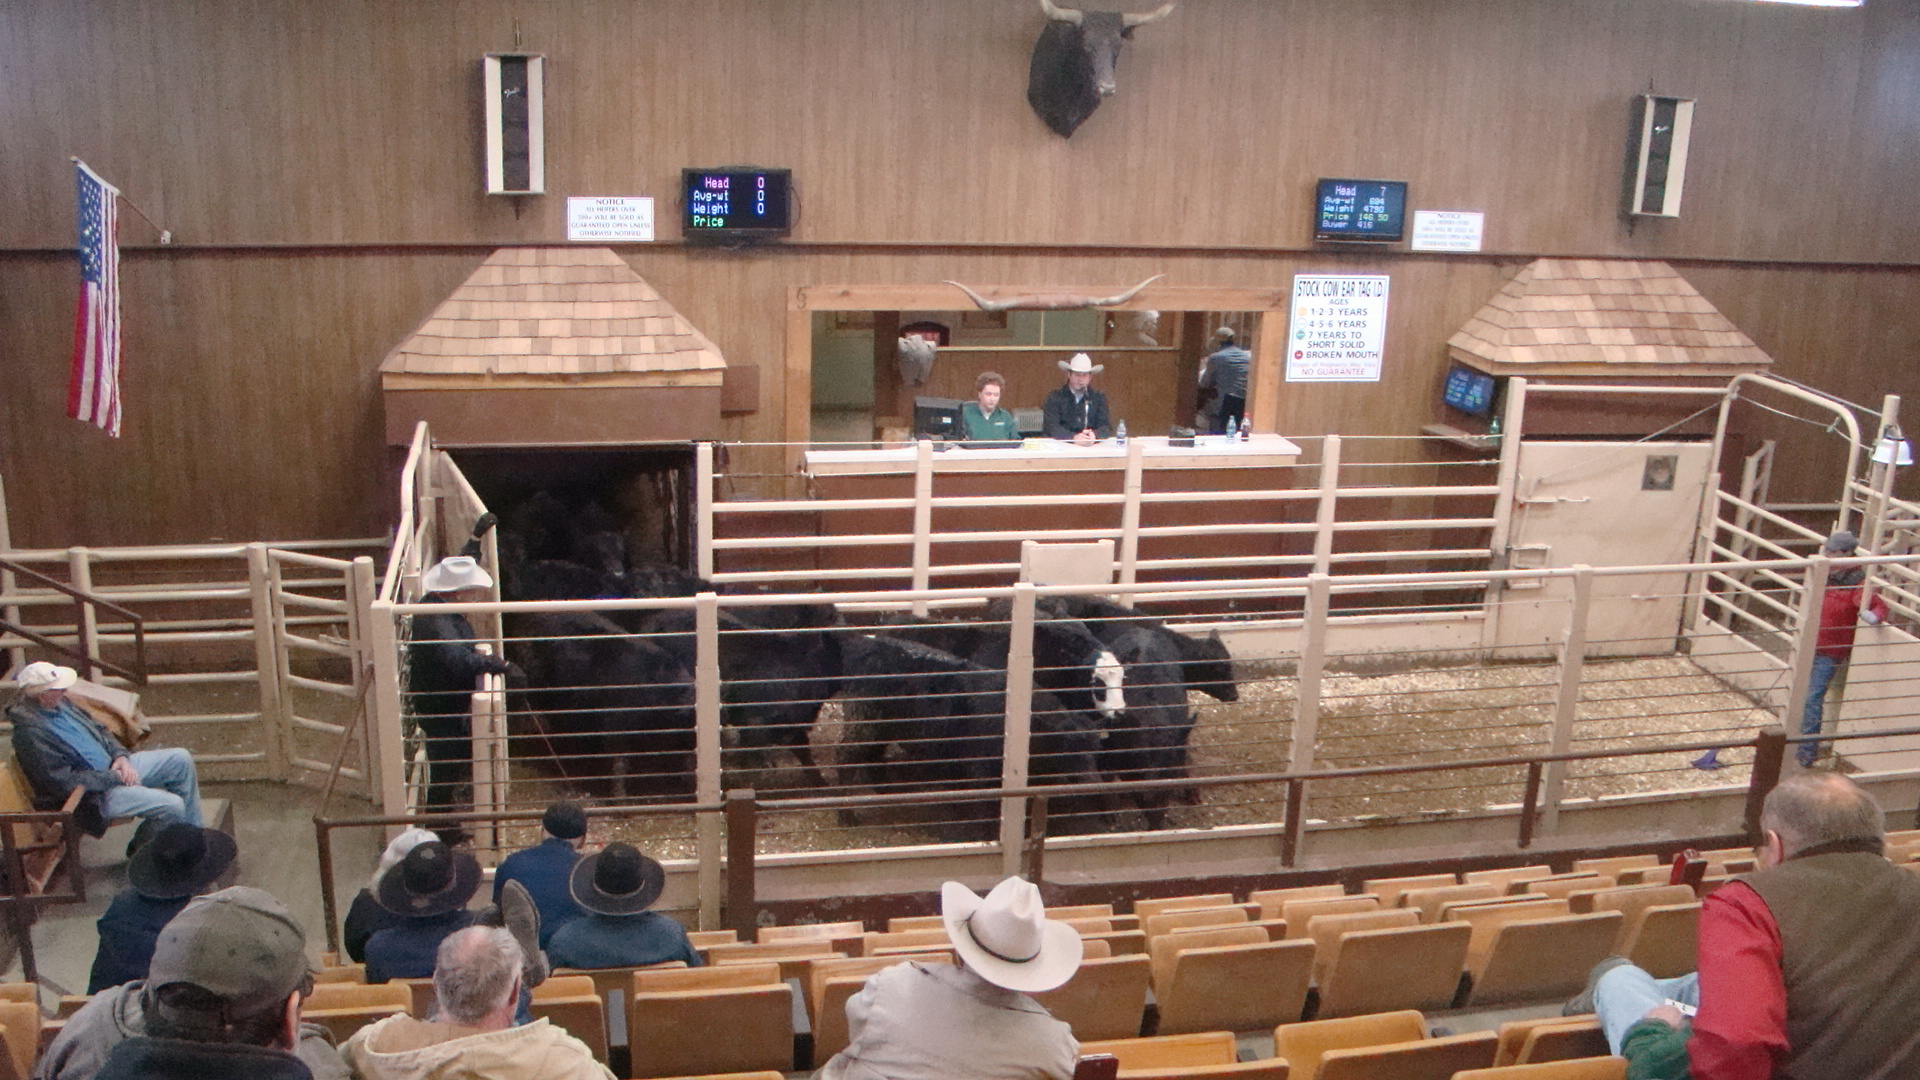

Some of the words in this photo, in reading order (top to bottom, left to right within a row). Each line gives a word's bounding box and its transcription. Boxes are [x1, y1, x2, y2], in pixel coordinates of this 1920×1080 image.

[705, 177, 729, 188] Head
[757, 177, 765, 188] 0
[1335, 185, 1356, 196] Head
[1380, 186, 1387, 196] 7
[693, 190, 729, 202] Avg-wt
[757, 190, 765, 201] 0
[1324, 196, 1354, 205] Avg-wt
[693, 203, 729, 215] Weight
[757, 203, 765, 214] 0
[1323, 204, 1354, 212] Weight
[1363, 205, 1385, 214] 4790
[1322, 212, 1349, 220] Price
[693, 216, 724, 227] Price
[1322, 220, 1348, 228] Buyer
[1357, 221, 1374, 229] 416
[1298, 281, 1320, 297] STOCK
[1323, 281, 1339, 297] COW
[1341, 281, 1356, 297] EAR
[1358, 281, 1371, 297] TAG
[1311, 308, 1334, 316] 1-2-3
[1338, 308, 1368, 316] YEARS
[1309, 320, 1334, 328] 4-5-6
[1337, 320, 1367, 328] YEARS
[1308, 331, 1314, 339] 7
[1317, 331, 1347, 339] YEARS
[1351, 331, 1362, 339] TO
[1307, 341, 1335, 349] SHORT
[1339, 341, 1365, 349] SOLID
[1306, 351, 1342, 359] BROKEN
[1346, 351, 1379, 359] MOUTH
[1302, 368, 1314, 376] NO
[1317, 368, 1365, 376] GUARANTEE
